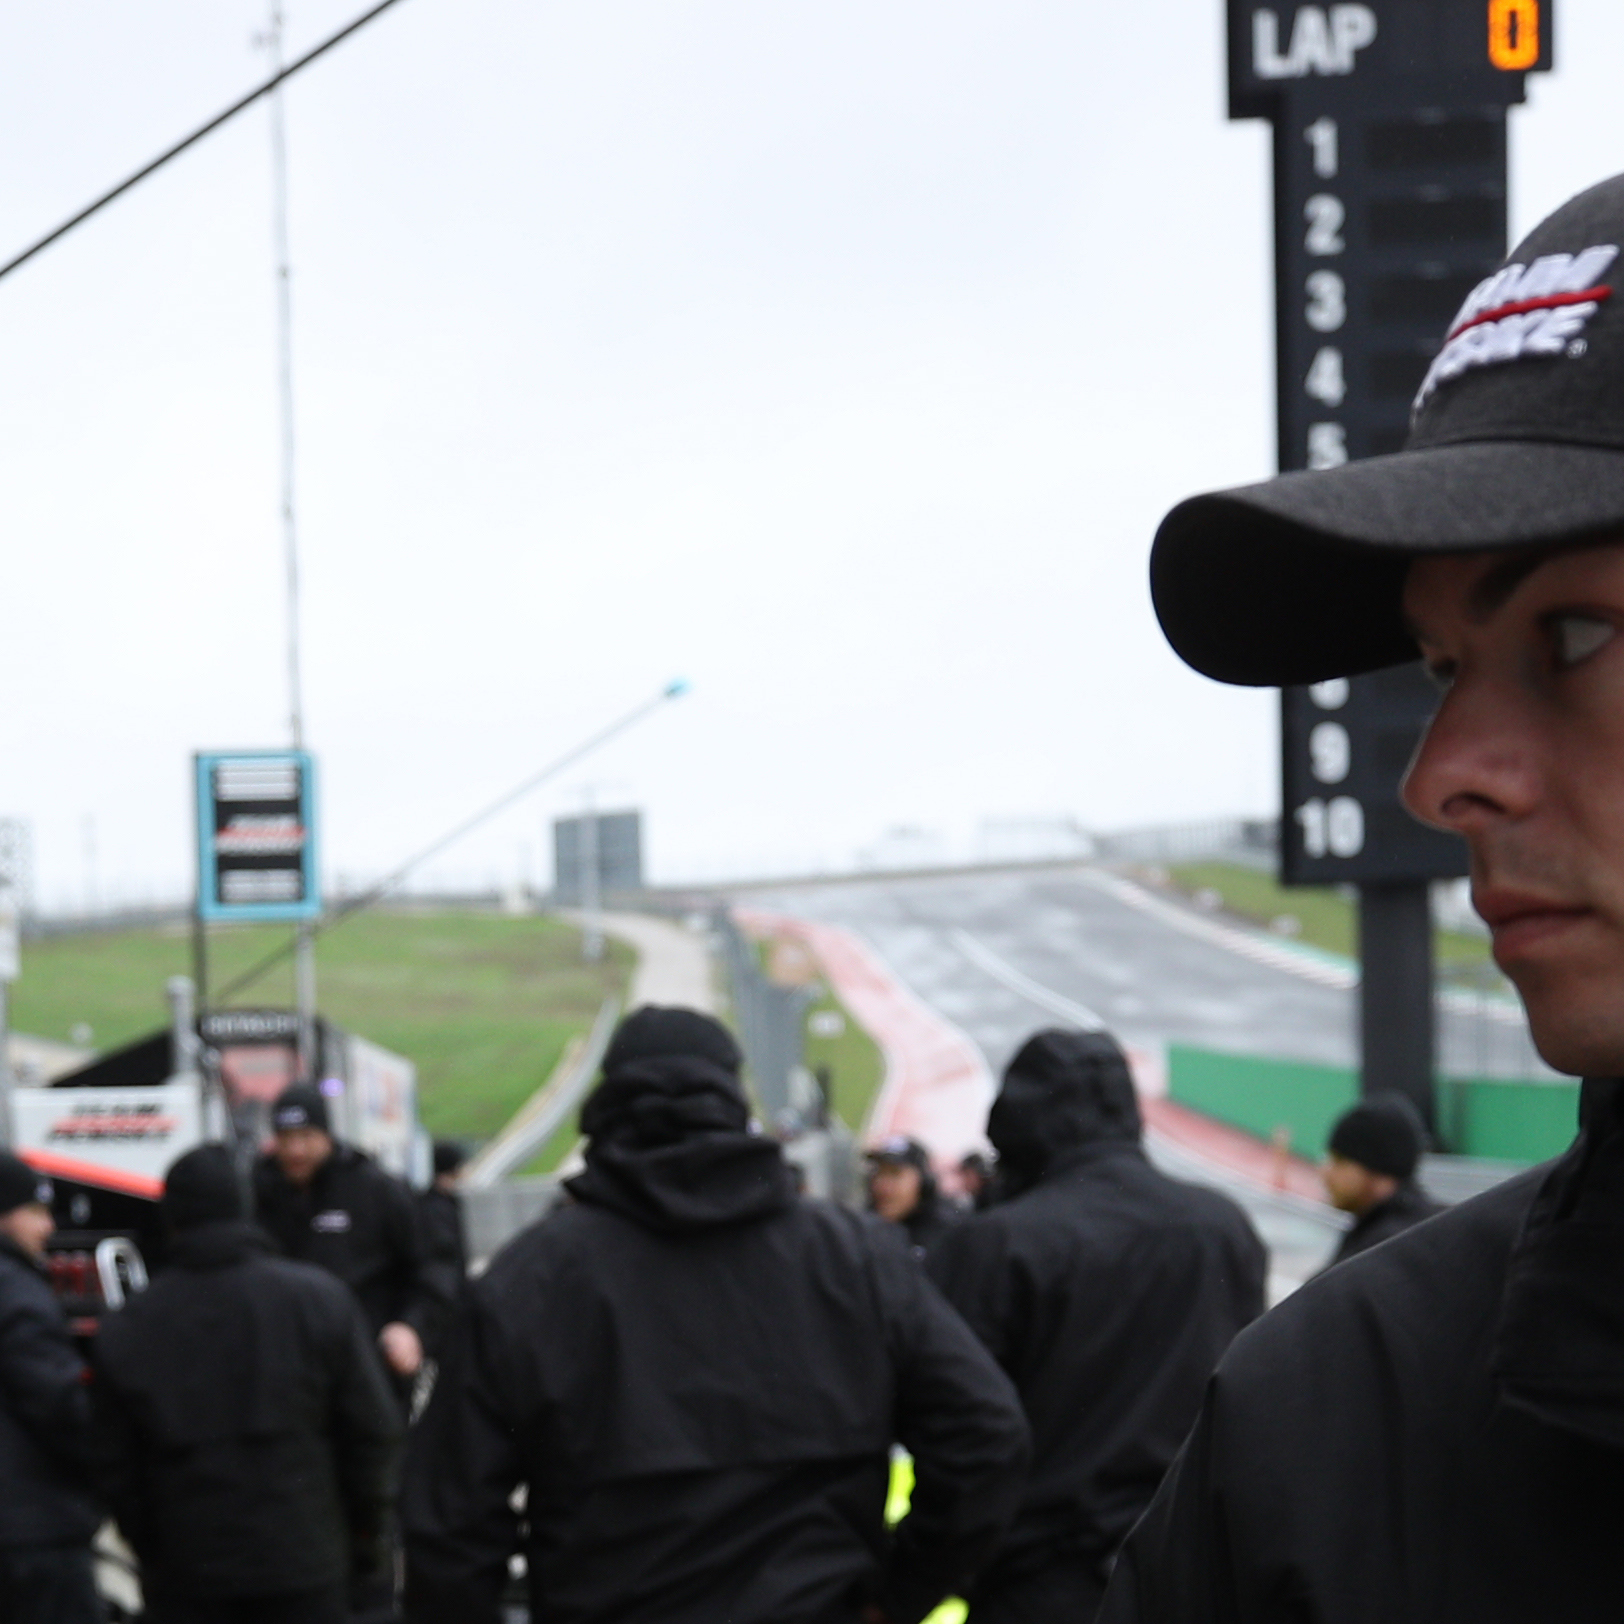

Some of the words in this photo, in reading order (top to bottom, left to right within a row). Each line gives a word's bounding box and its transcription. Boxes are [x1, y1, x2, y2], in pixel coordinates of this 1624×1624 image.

[1251, 3, 1377, 79] LAP
[1487, 0, 1540, 71] 0
[1303, 115, 1339, 180] 1
[1303, 192, 1346, 257] 2
[1303, 269, 1348, 334] 3
[1303, 345, 1348, 408] 4
[1305, 421, 1349, 471] 5
[1308, 720, 1351, 785] 9
[1294, 795, 1365, 859] 10
